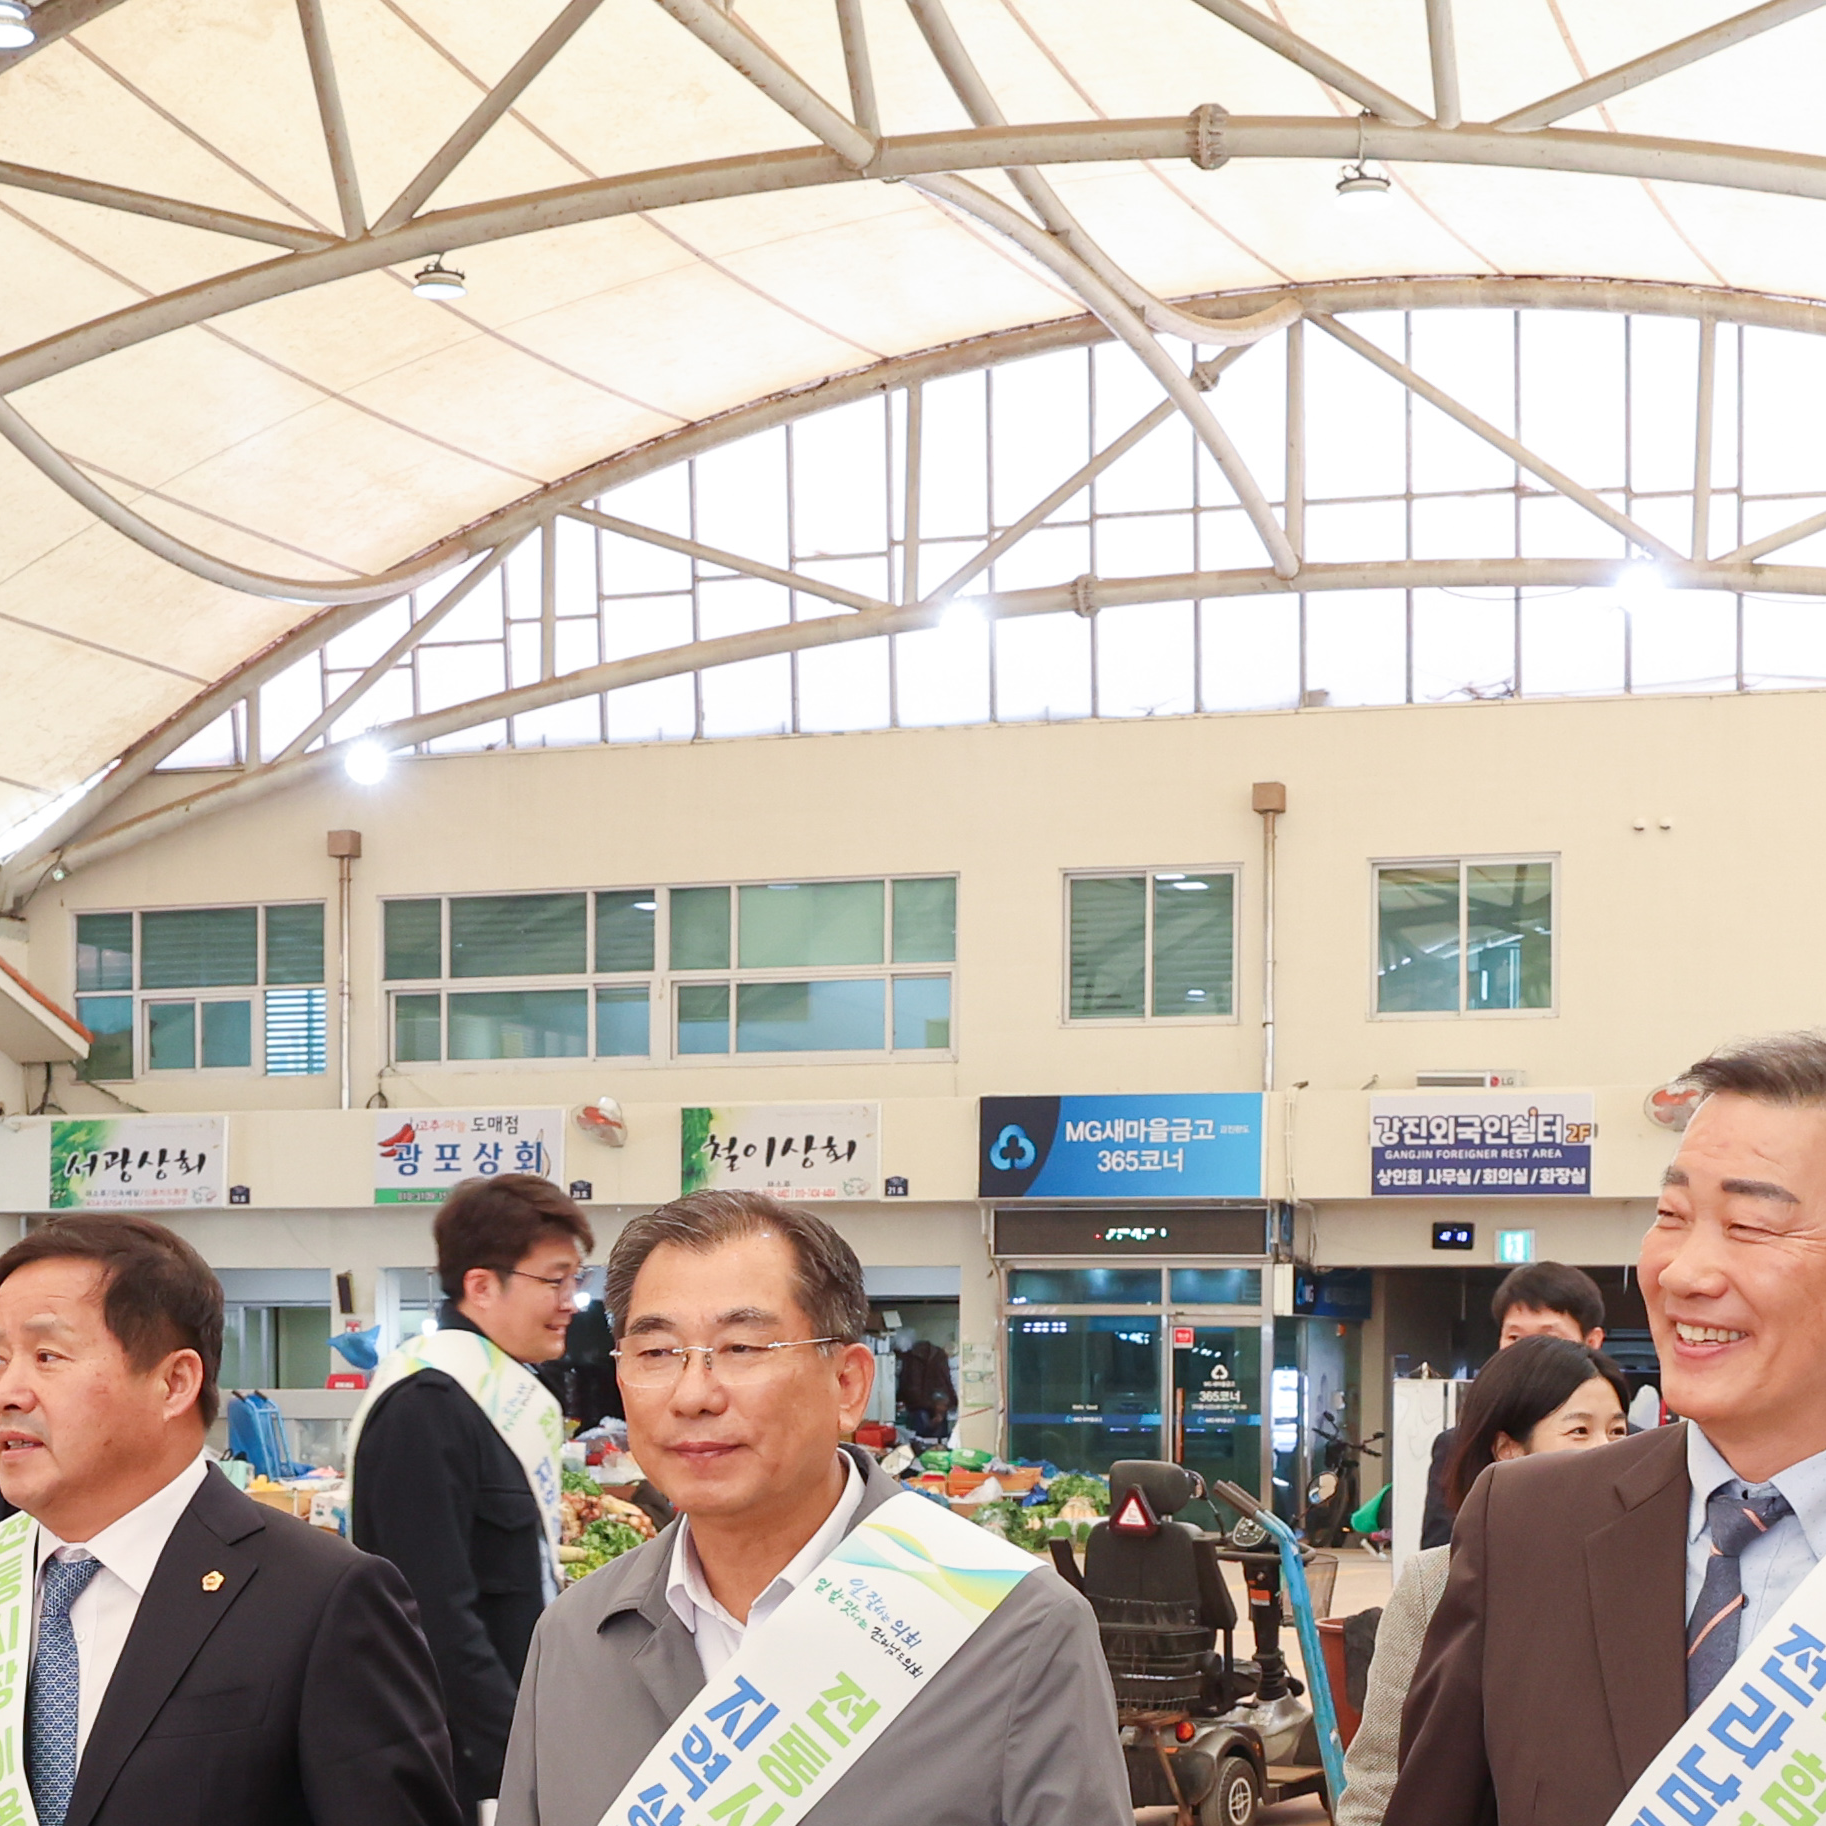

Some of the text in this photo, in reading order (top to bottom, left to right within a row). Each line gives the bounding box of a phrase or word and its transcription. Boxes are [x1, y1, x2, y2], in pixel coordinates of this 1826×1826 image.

[1501, 1077, 1514, 1086] LG
[470, 1115, 519, 1135] 도매점
[1065, 1117, 1216, 1143] MG새마을금고
[1374, 1106, 1592, 1146] 강진외국인쉼터 2F
[65, 1147, 206, 1183] 서광상회
[393, 1140, 543, 1176] 광포상회
[703, 1134, 857, 1172] 철이상회
[1096, 1147, 1185, 1173] 365코너
[1384, 1148, 1563, 1160] GANGJIN FOREIGNER REST AREA
[1377, 1168, 1423, 1186] 상인회
[1198, 1389, 1241, 1403] 365코너
[890, 1619, 922, 1650] 의회
